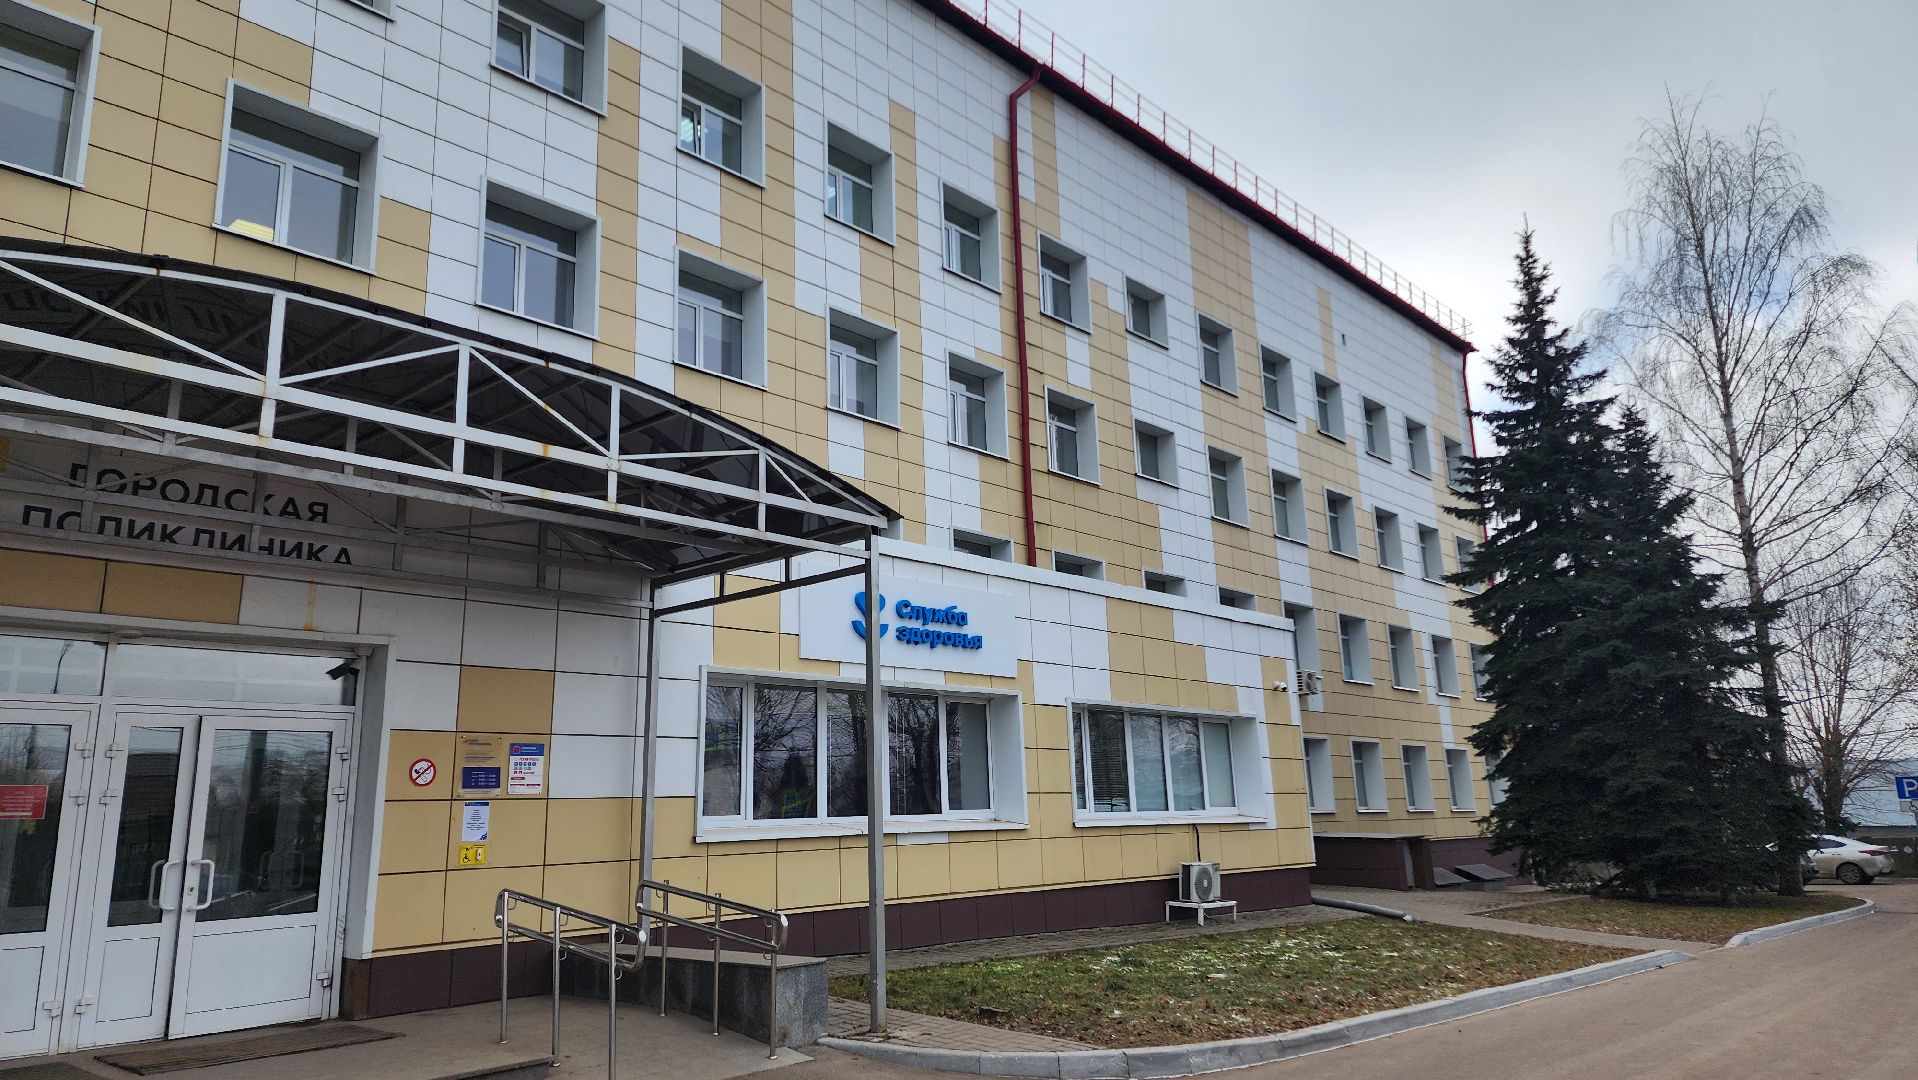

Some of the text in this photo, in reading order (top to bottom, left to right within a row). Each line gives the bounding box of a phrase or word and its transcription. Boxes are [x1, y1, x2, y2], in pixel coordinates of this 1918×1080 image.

[896, 599, 968, 626] Служба
[896, 626, 982, 649] здоровья
[1903, 778, 1918, 797] P
